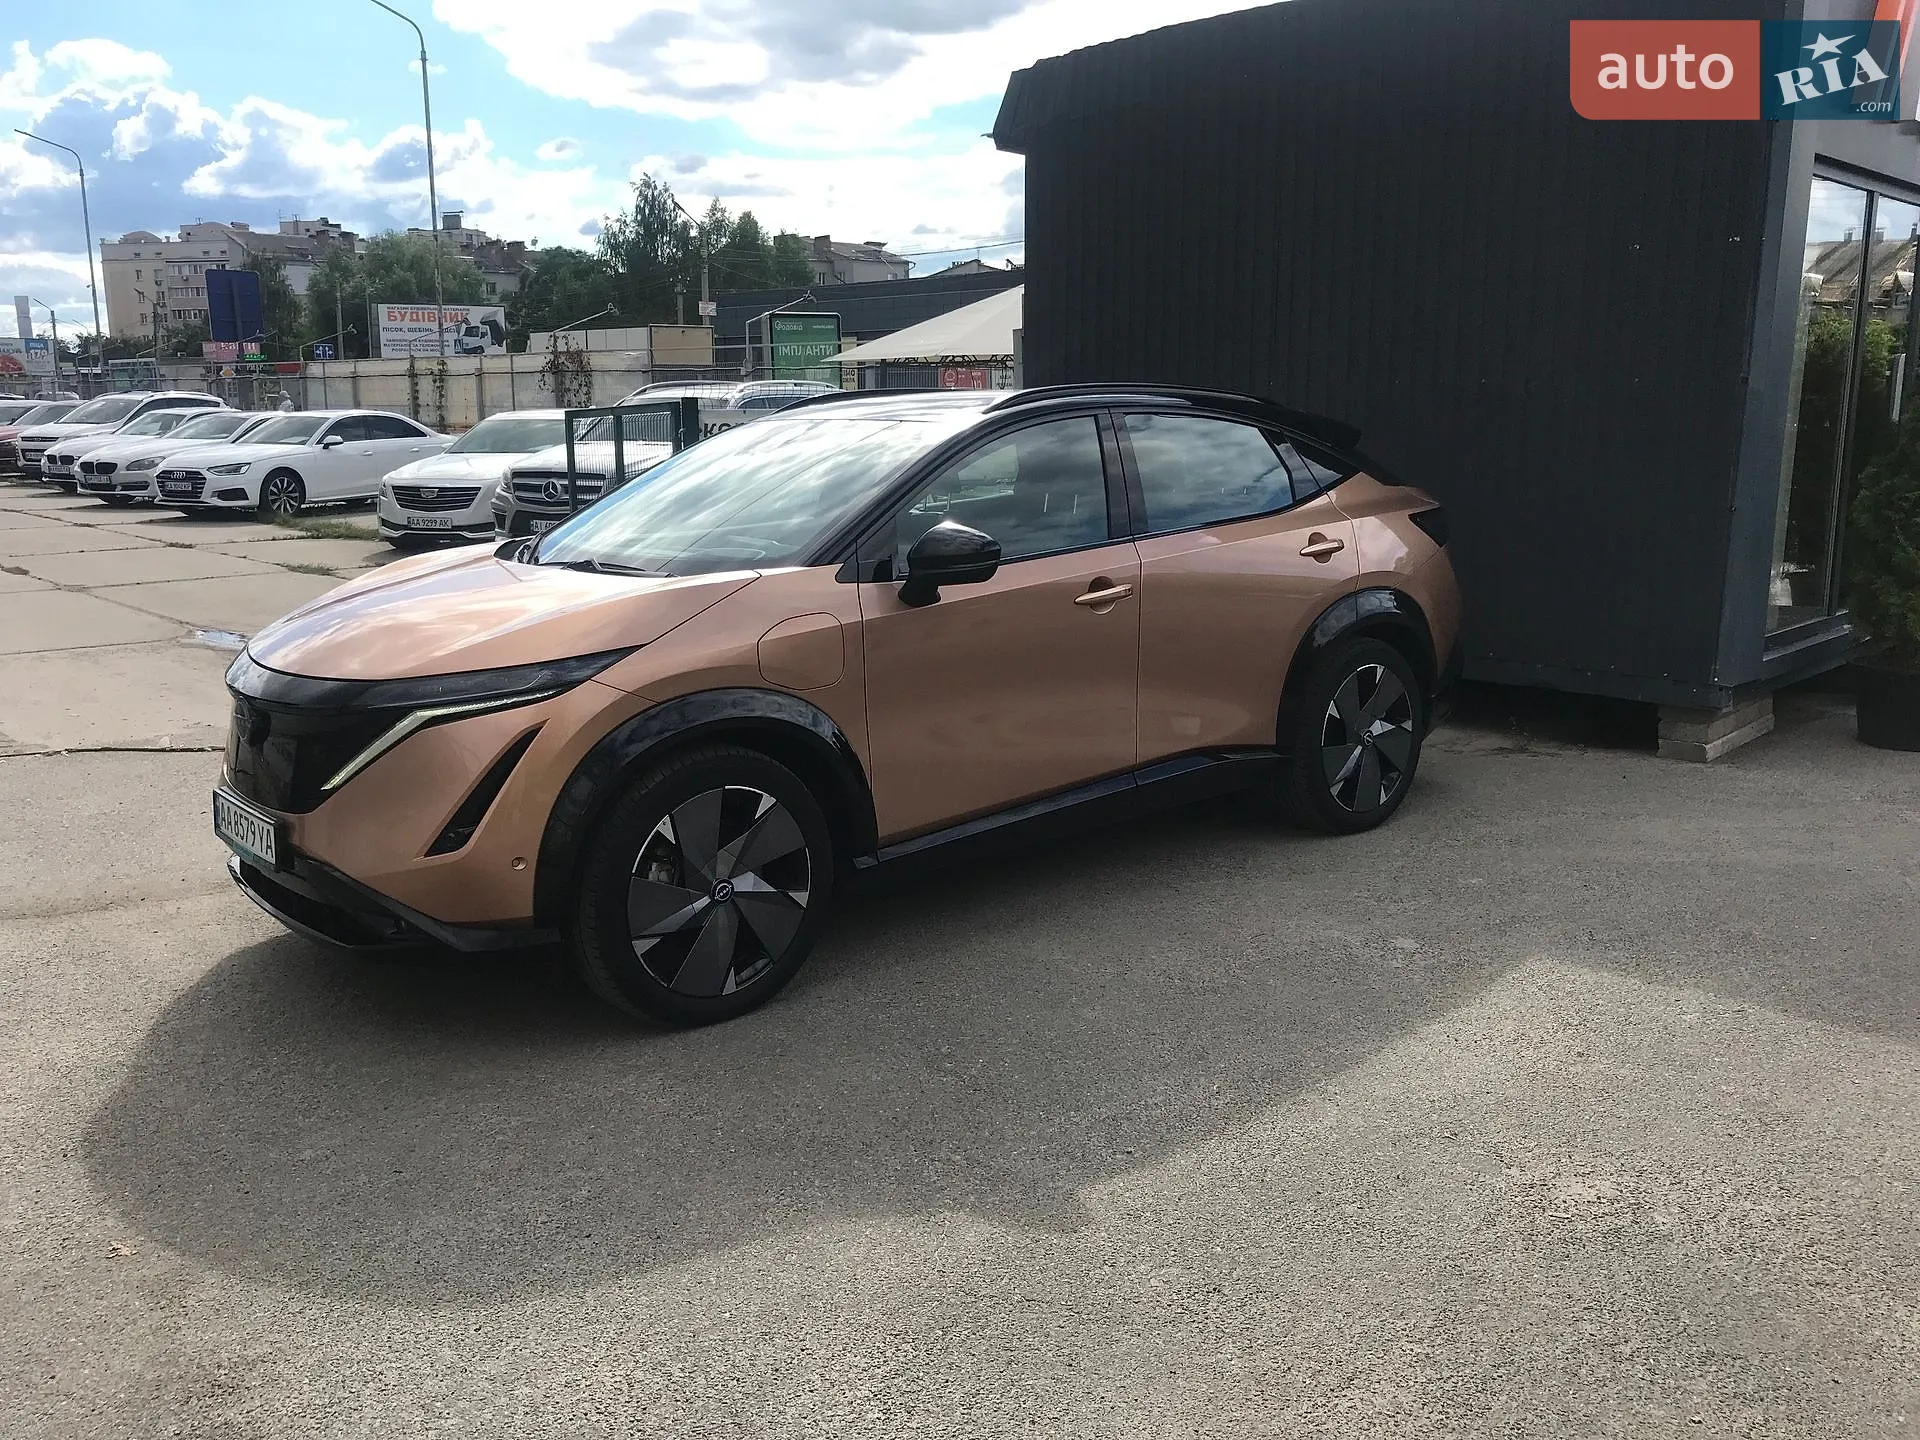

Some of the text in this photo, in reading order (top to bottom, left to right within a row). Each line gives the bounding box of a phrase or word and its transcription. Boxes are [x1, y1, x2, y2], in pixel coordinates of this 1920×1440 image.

[221, 802, 274, 859] AA 8579 YA
